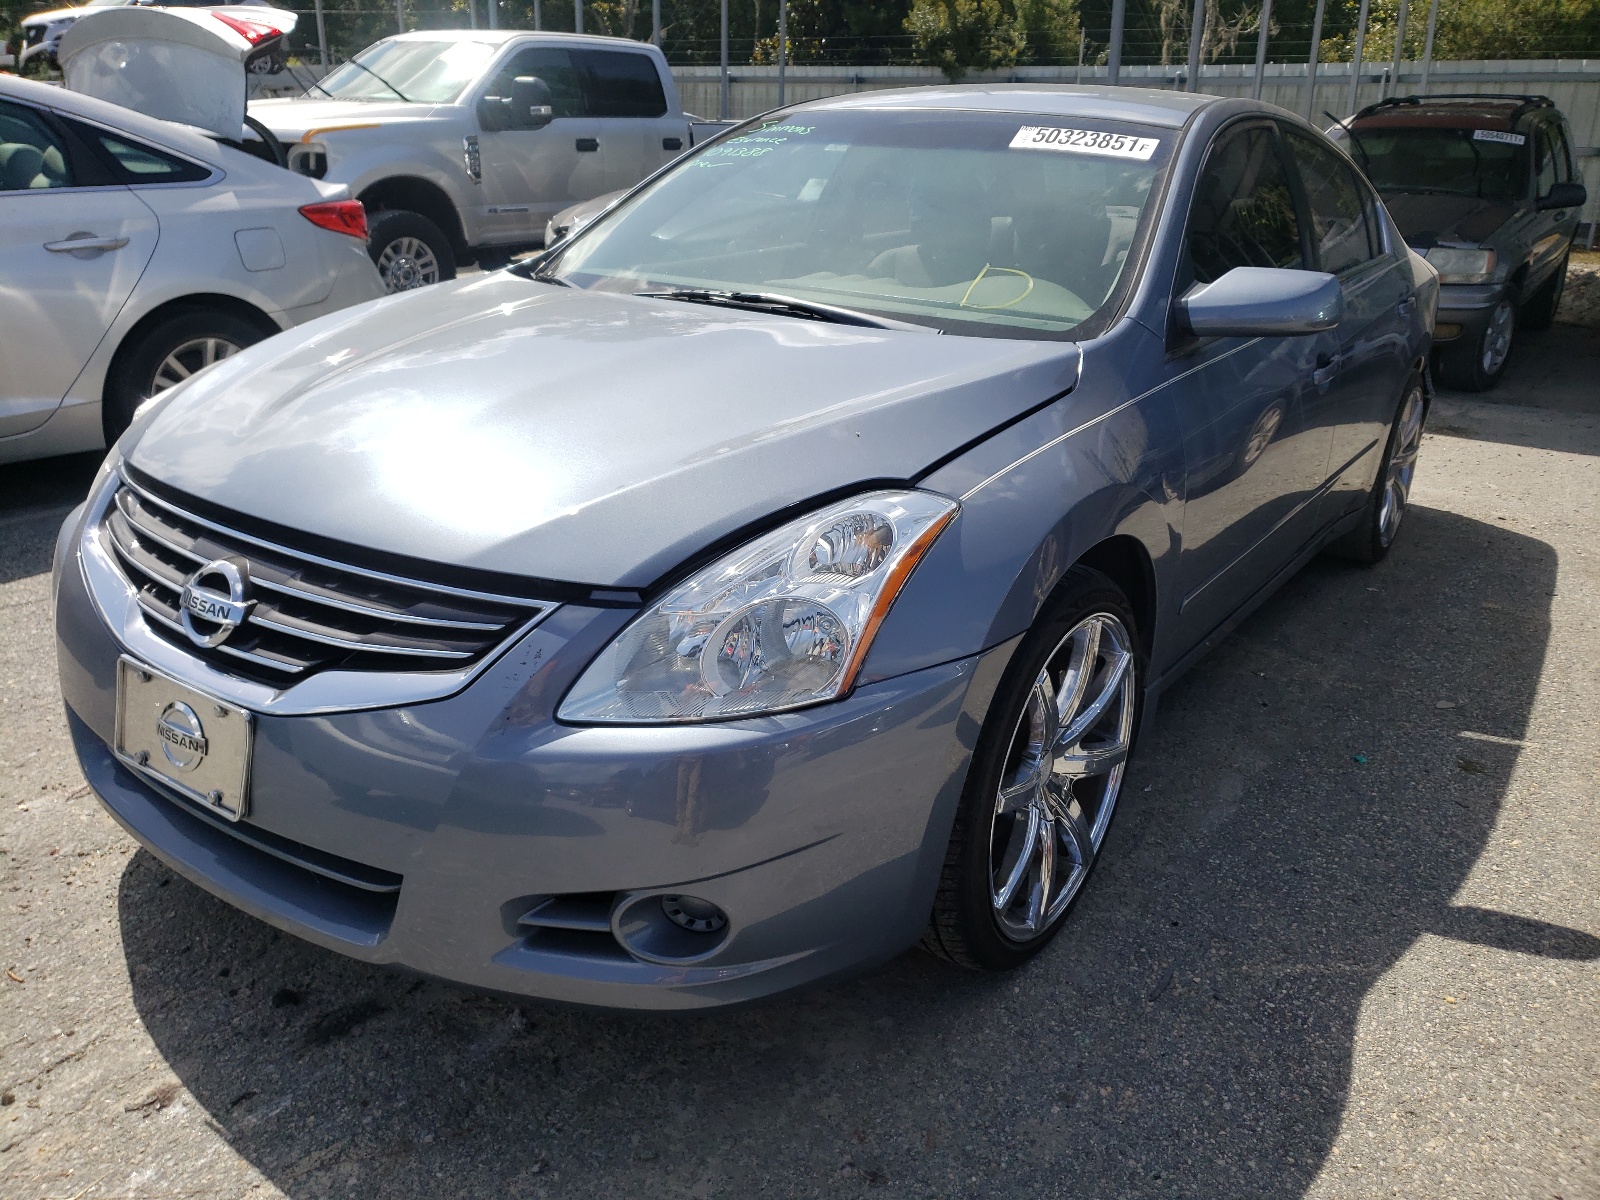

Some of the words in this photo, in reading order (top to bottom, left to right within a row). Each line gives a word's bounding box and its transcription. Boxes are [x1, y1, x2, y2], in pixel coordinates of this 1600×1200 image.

[1032, 128, 1139, 151] 50323851
[181, 587, 231, 620] NISSAN
[157, 722, 199, 752] NISSAN
